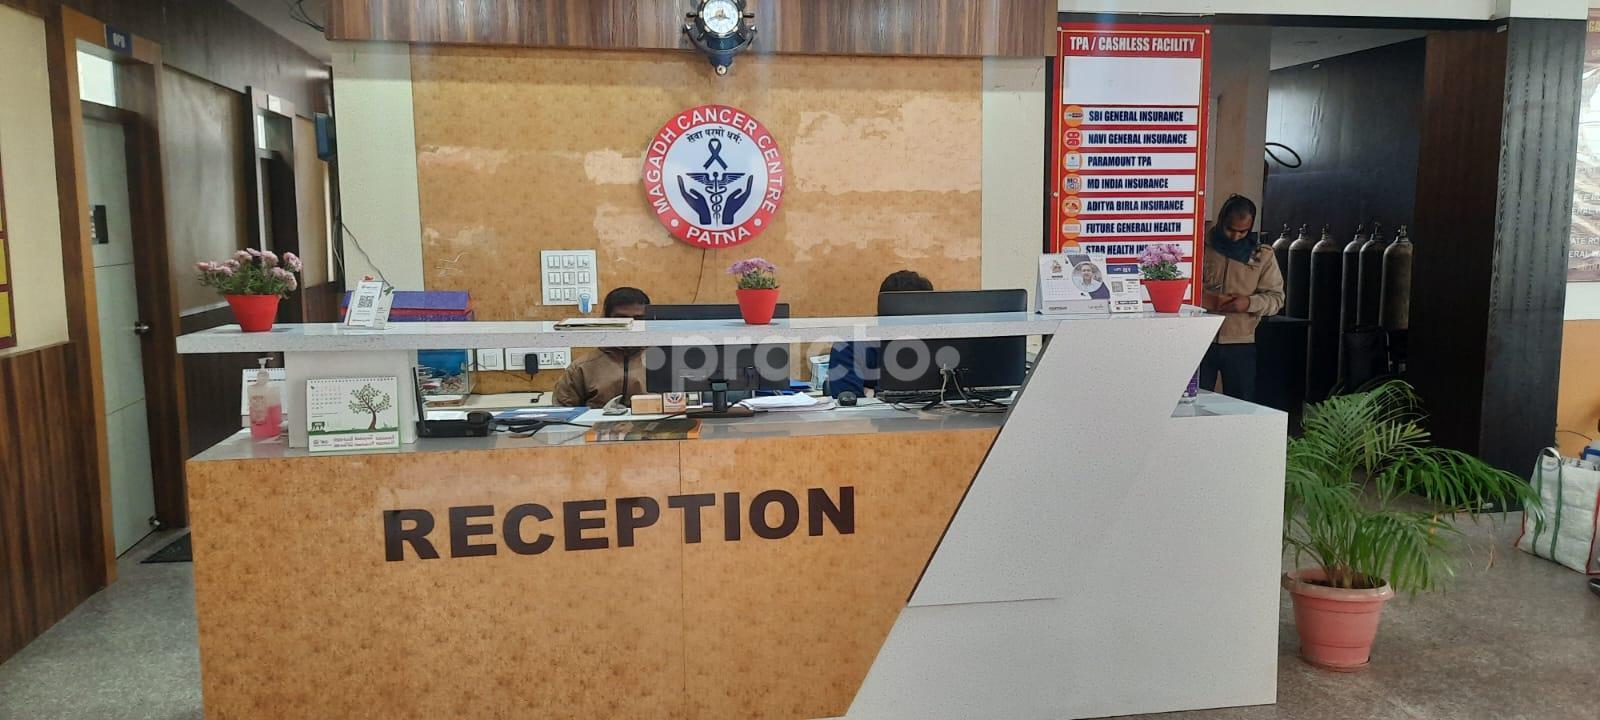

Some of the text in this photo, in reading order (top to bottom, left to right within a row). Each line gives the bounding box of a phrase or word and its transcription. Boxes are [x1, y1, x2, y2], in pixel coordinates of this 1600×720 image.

[1070, 36, 1196, 52] TPA / CASHLESS FACILITY
[1088, 110, 1103, 122] SBI
[1103, 110, 1138, 122] GENERAL
[1139, 110, 1184, 122] INSURANCE
[1088, 133, 1188, 144] NAVI GENERAL INSURANCE
[647, 108, 783, 215] MAGADH CANCER CENTRE
[1087, 156, 1152, 167] PARAMOUNT TPA
[1087, 178, 1100, 189] MD
[1101, 178, 1123, 189] INDIA
[1124, 178, 1169, 189] INSURANCE
[1086, 200, 1184, 212] ADITYA BIRLA INSURANCE
[1086, 221, 1182, 234] FUTURE GENERALI HEALTH
[686, 226, 751, 245] PATNA
[1086, 244, 1106, 254] STAR
[1107, 244, 1135, 255] HEALTH
[382, 486, 856, 562] RECEPTION
